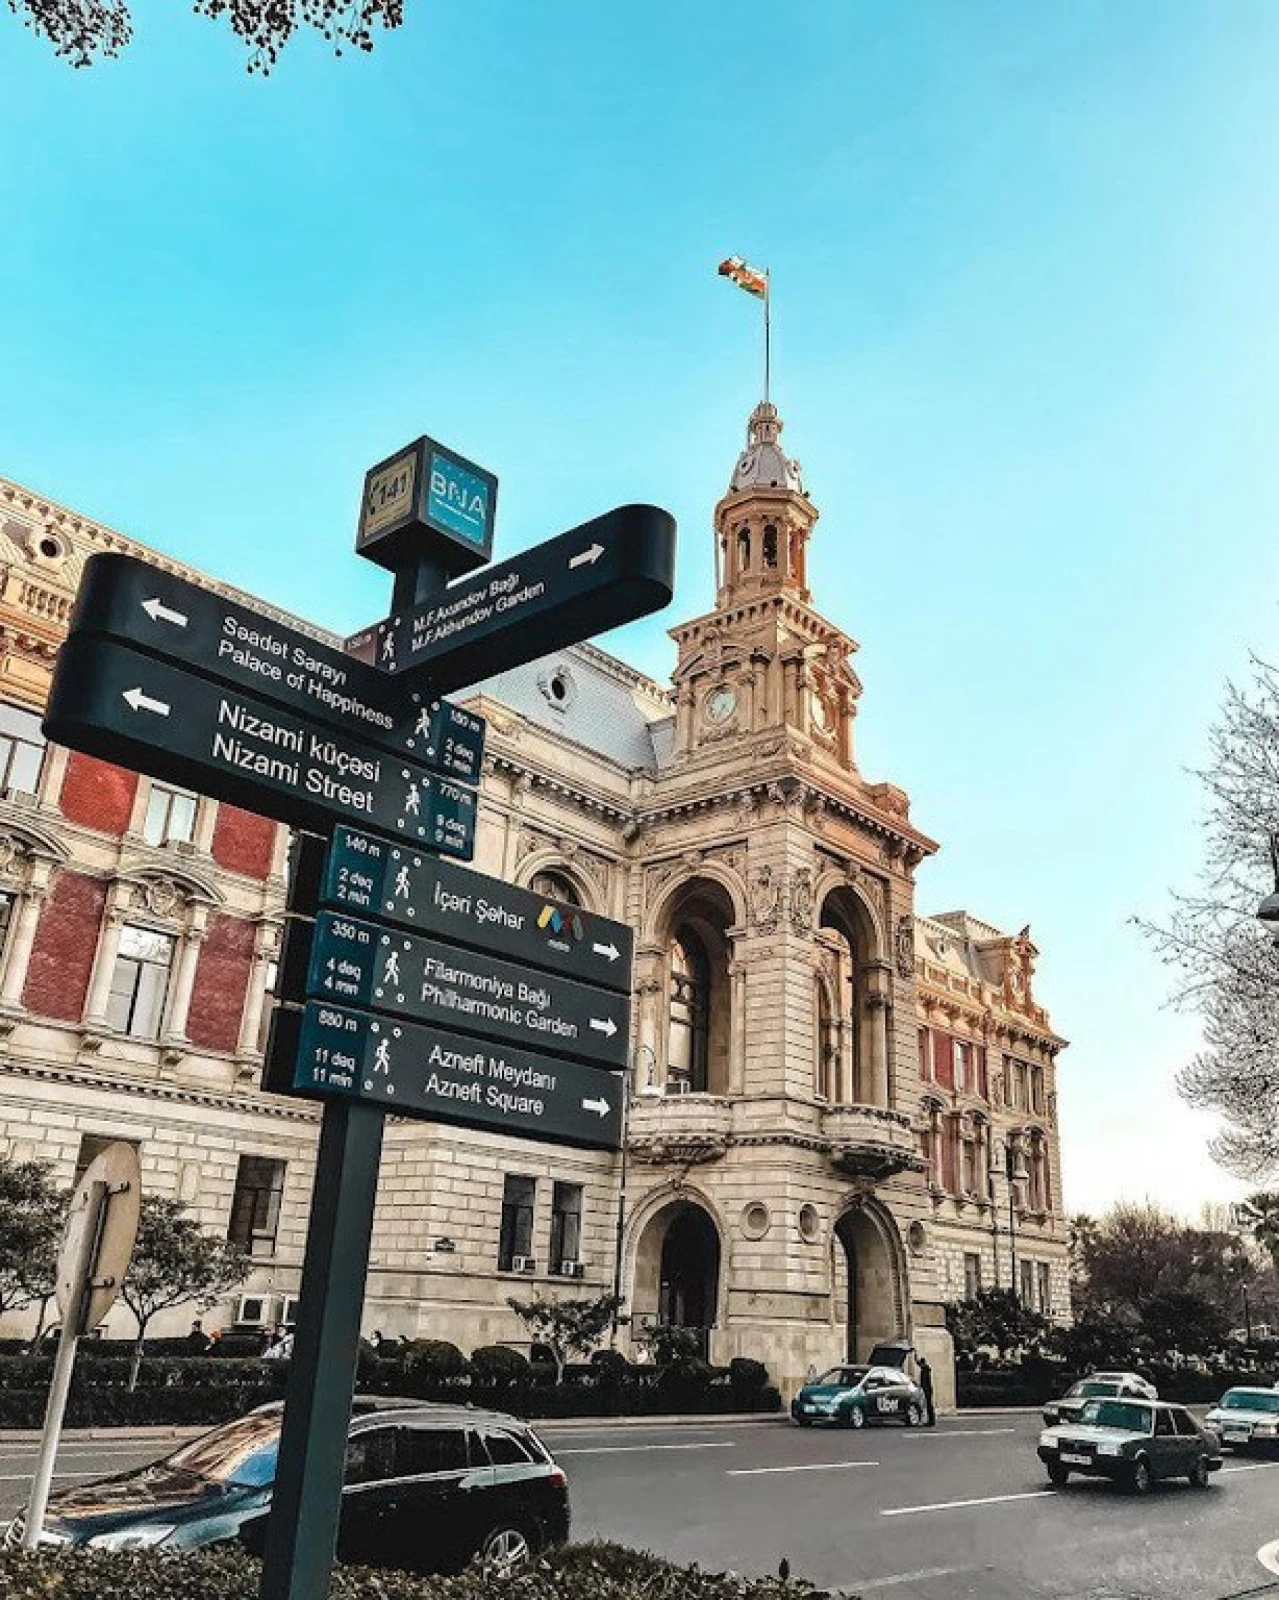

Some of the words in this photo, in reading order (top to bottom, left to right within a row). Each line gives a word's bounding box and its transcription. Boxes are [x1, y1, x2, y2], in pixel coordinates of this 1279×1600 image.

[495, 582, 545, 612] Garden
[222, 615, 288, 659] Səadət
[292, 647, 347, 686] Sarayı
[218, 639, 282, 680] Palace
[286, 672, 305, 691] of
[308, 678, 393, 730] Happiness
[217, 699, 304, 753] Nizami
[309, 734, 380, 783] küçəsi
[211, 732, 300, 786] Nizami
[305, 768, 374, 814] Street
[460, 793, 472, 805] m
[345, 834, 368, 853] 140
[368, 845, 380, 857] m
[339, 866, 348, 882] 2
[337, 884, 347, 899] 2
[347, 890, 370, 906] min
[358, 930, 370, 944] m
[326, 957, 336, 971] 4
[324, 976, 333, 989] 4
[334, 980, 359, 995] min
[424, 957, 514, 999] Filarmoniya
[517, 982, 551, 1010] Bağı
[420, 982, 522, 1025] Philharmonic
[526, 1010, 579, 1039] Garden
[345, 1018, 357, 1032] m
[314, 1047, 328, 1063] 11
[313, 1066, 326, 1082] 11
[328, 1072, 353, 1088] min
[428, 1045, 484, 1076] Azneft
[488, 1057, 557, 1091] Meydanı
[424, 1072, 482, 1103] Azneft
[485, 1085, 545, 1115] Square
